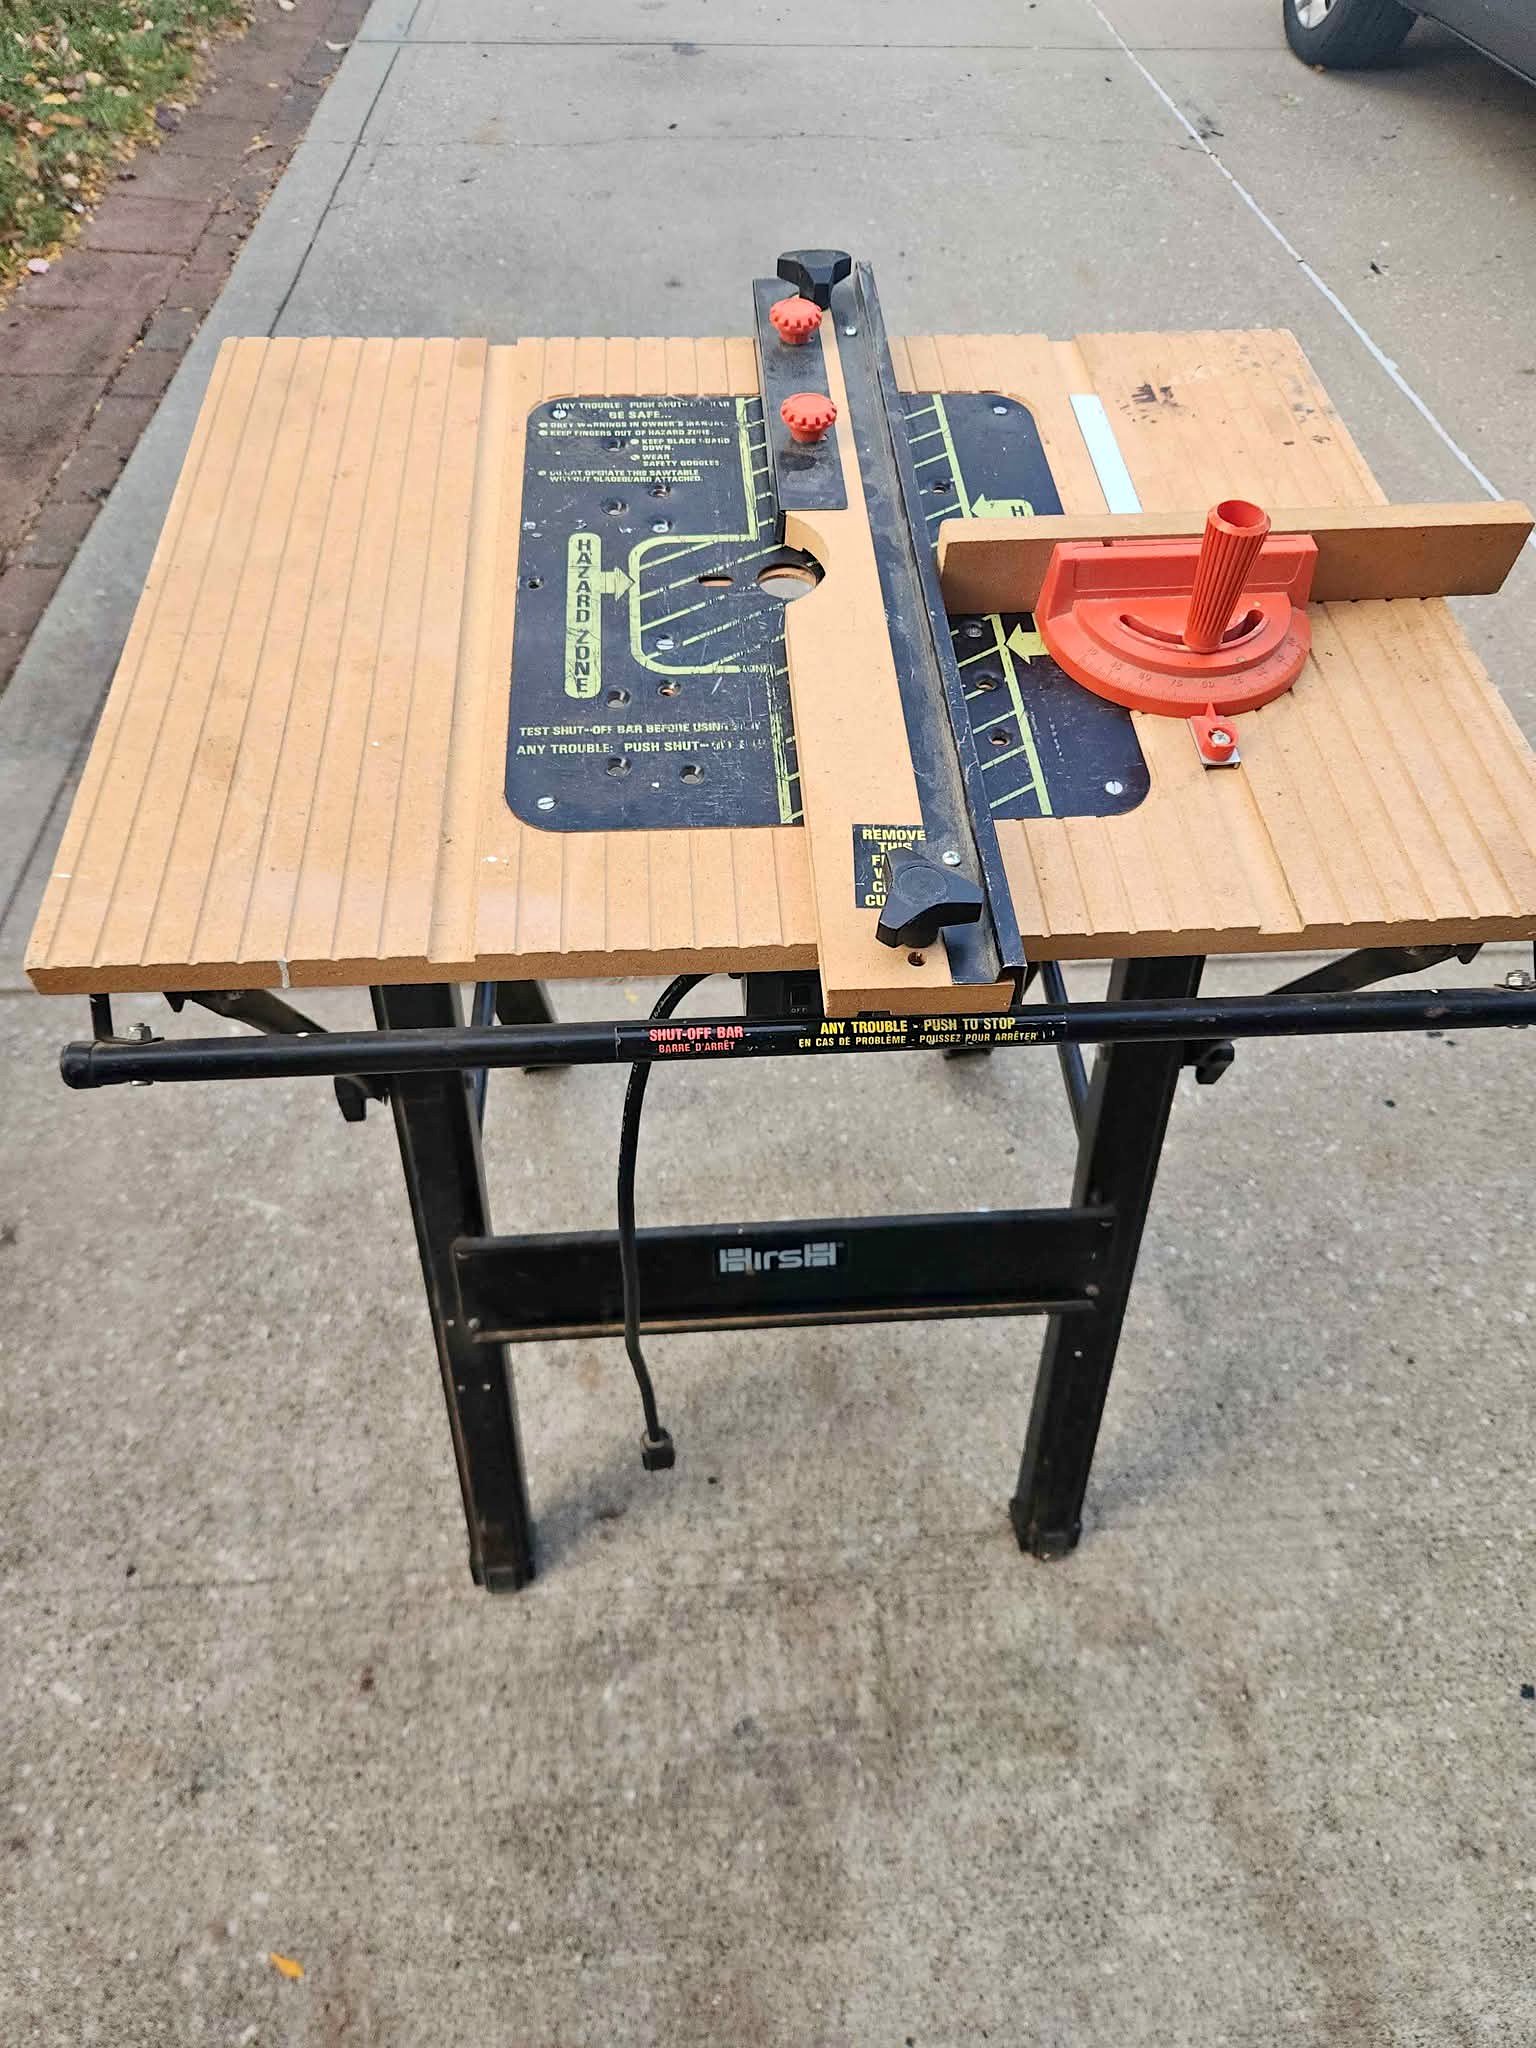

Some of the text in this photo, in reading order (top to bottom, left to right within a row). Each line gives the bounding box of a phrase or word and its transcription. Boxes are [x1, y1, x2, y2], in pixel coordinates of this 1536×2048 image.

[609, 411, 625, 419] BE
[575, 538, 592, 623] HAZARD
[574, 629, 591, 693] ZONE
[520, 727, 550, 736] TEST
[617, 725, 642, 734] BAR
[645, 723, 690, 733] BEFORE
[517, 744, 546, 754] ANY
[550, 743, 614, 754] TROUBLE:
[624, 742, 660, 752] PUSH
[862, 829, 926, 840] REMOVE
[820, 1022, 845, 1034] ANY
[851, 1020, 908, 1034] TROUBLE
[923, 1019, 957, 1031] PUSH
[962, 1018, 978, 1030] TO
[983, 1017, 1016, 1030] STOP
[650, 1026, 744, 1041] SHUT-OFF BAR
[799, 1038, 811, 1047] EN
[815, 1037, 834, 1046] CAS
[855, 1034, 906, 1045] PROBLÈME
[919, 1034, 961, 1044] POUSSEZ
[965, 1033, 990, 1042] POUR
[994, 1031, 1037, 1041] ARRÊTER
[658, 1040, 736, 1053] BARRE D'ARRÊT
